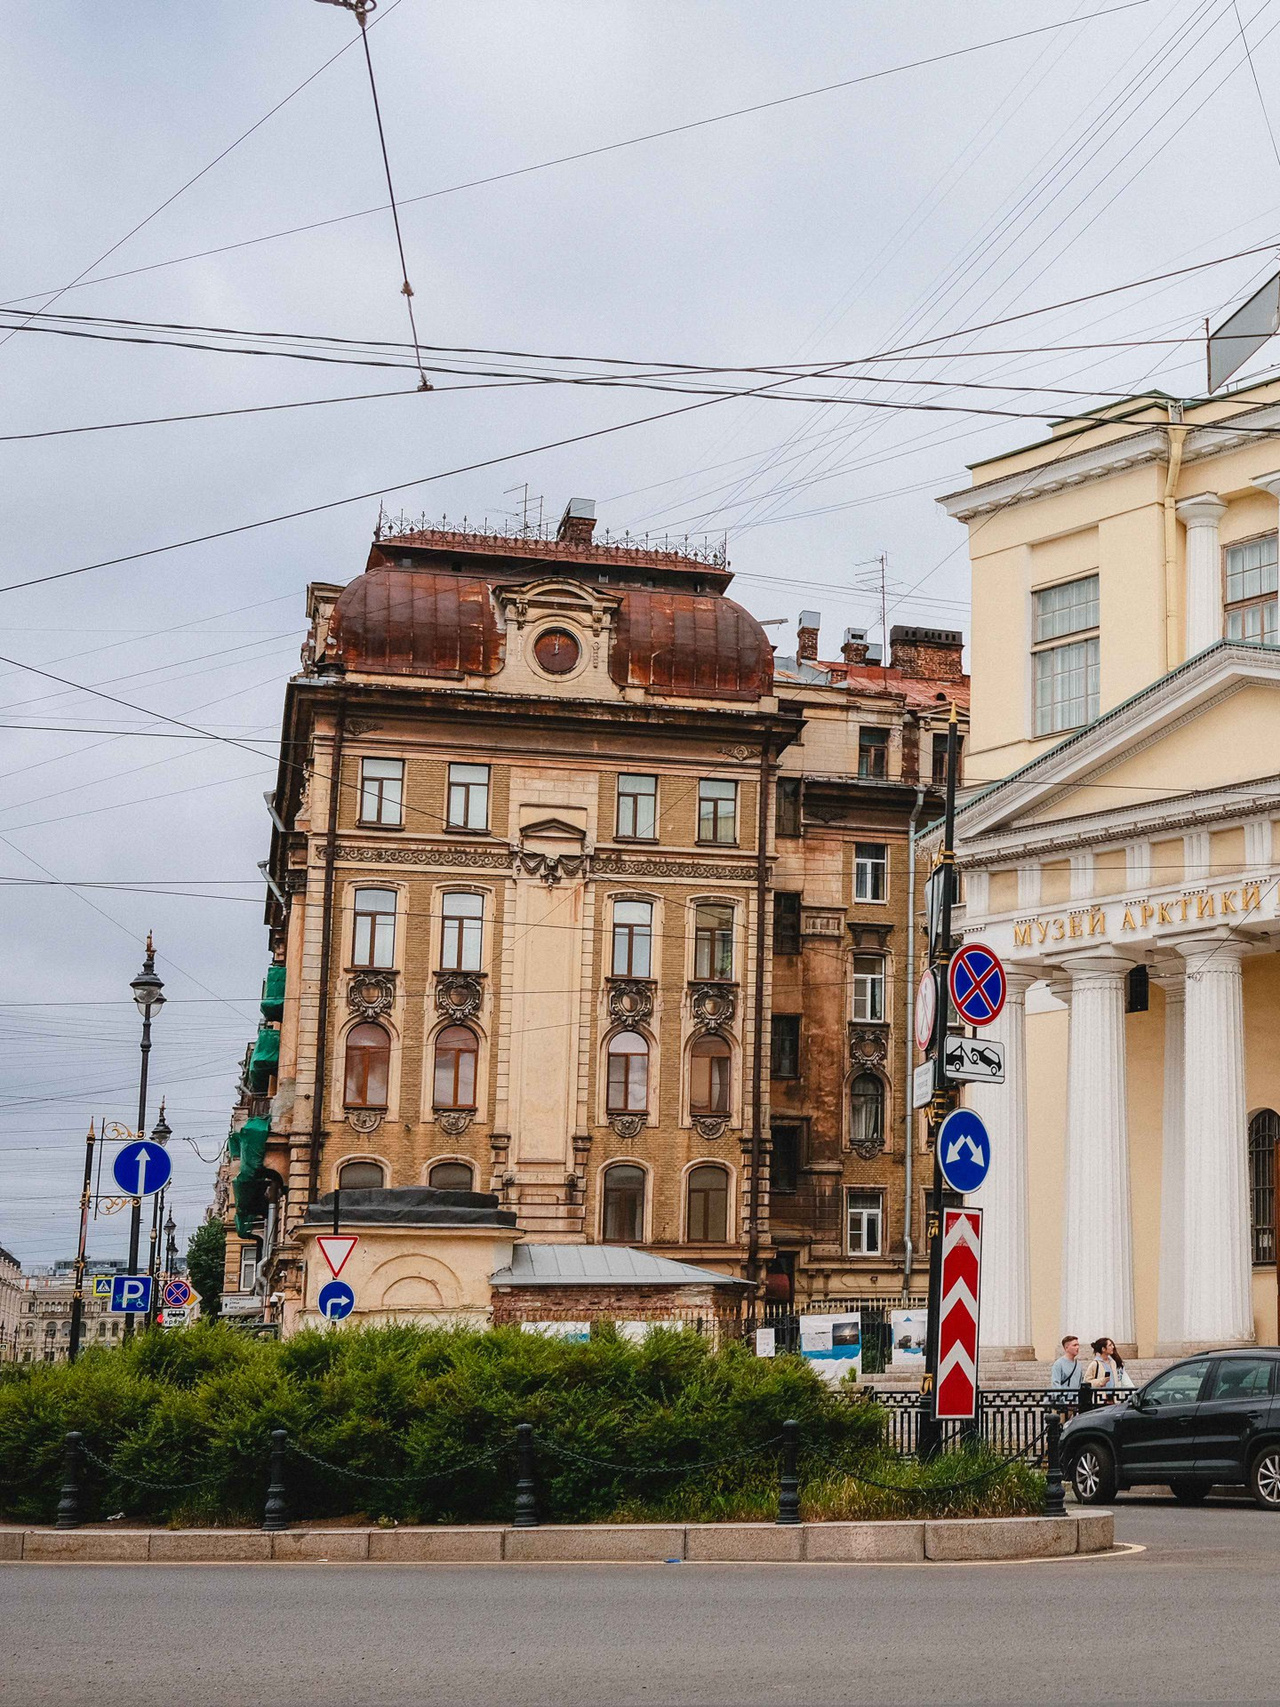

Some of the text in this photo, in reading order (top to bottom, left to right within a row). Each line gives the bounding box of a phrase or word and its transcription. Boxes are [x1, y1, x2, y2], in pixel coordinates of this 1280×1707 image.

[1013, 905, 1106, 947] МУЗЕЙ
[1120, 885, 1261, 931] АРКТИКИ
[122, 1280, 144, 1309] P
